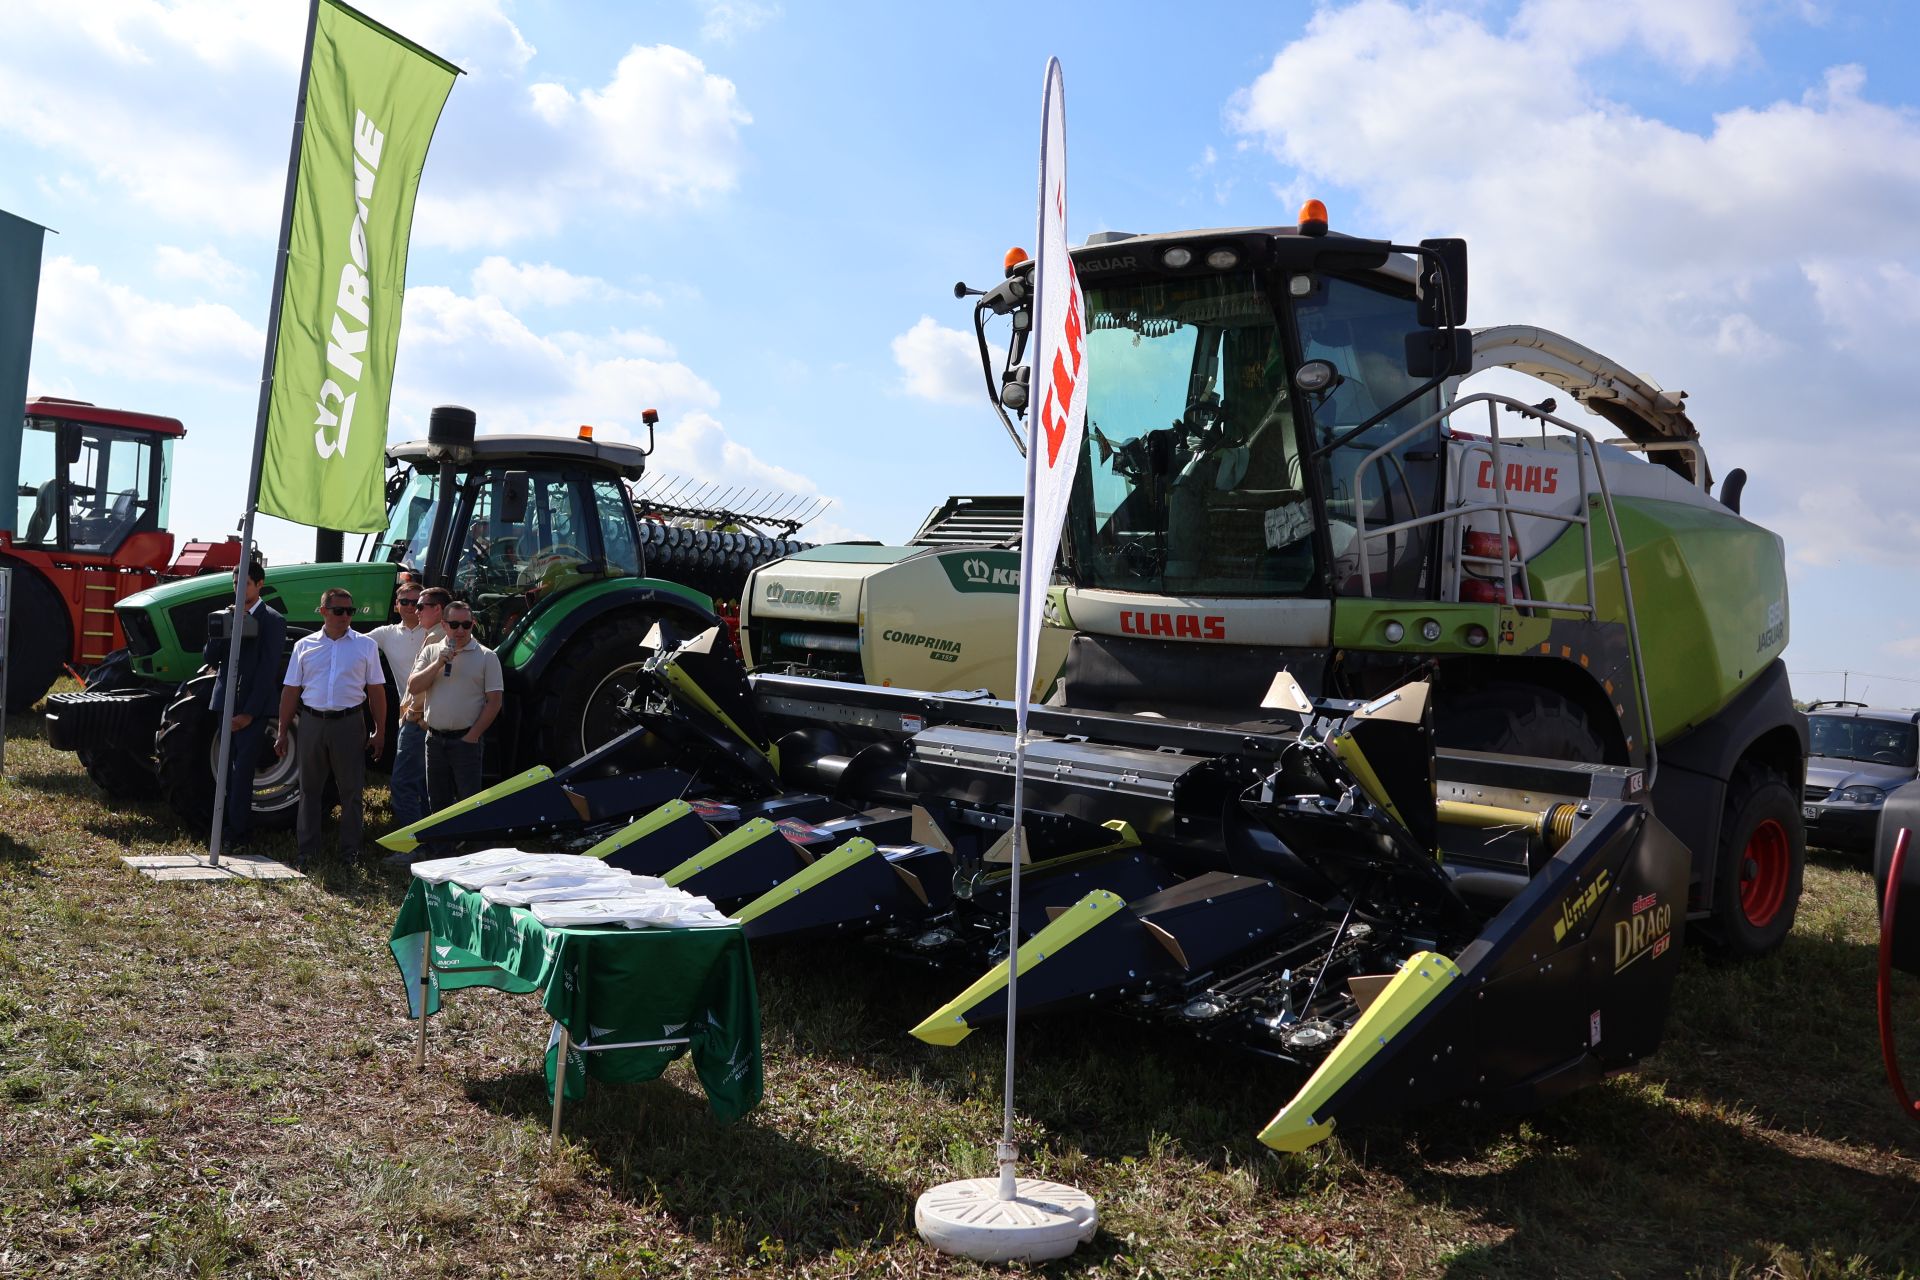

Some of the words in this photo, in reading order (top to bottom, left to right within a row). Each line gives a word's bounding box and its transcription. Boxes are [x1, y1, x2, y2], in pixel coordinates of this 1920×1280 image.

[326, 108, 385, 382] KRONE
[1077, 256, 1137, 273] AGUAR
[781, 588, 842, 607] KRONE
[1120, 611, 1225, 640] CLAAS
[882, 628, 962, 654] COMPRIMA
[1614, 903, 1671, 969] DRAGO
